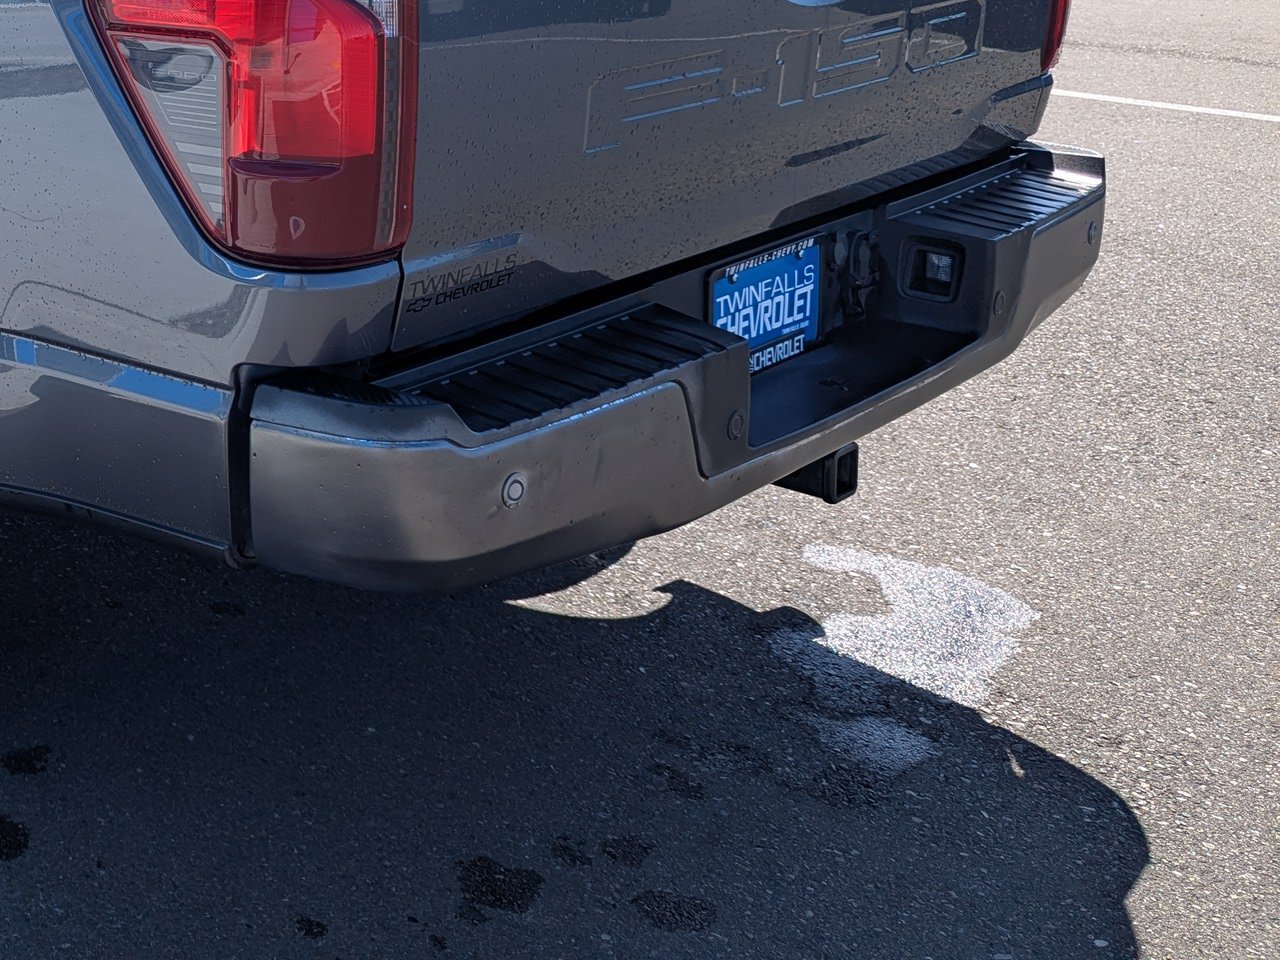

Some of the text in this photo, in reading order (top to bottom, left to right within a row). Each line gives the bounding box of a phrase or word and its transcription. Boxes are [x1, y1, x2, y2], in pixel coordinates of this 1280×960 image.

[152, 68, 217, 82] FORD
[409, 253, 518, 298] TWINFALLS
[725, 238, 815, 277] TWINFALLS-CHEVY.COM
[435, 272, 514, 306] CHEVROLET
[715, 264, 815, 316] TWINFALLS
[753, 334, 805, 371] CHEVROLET
